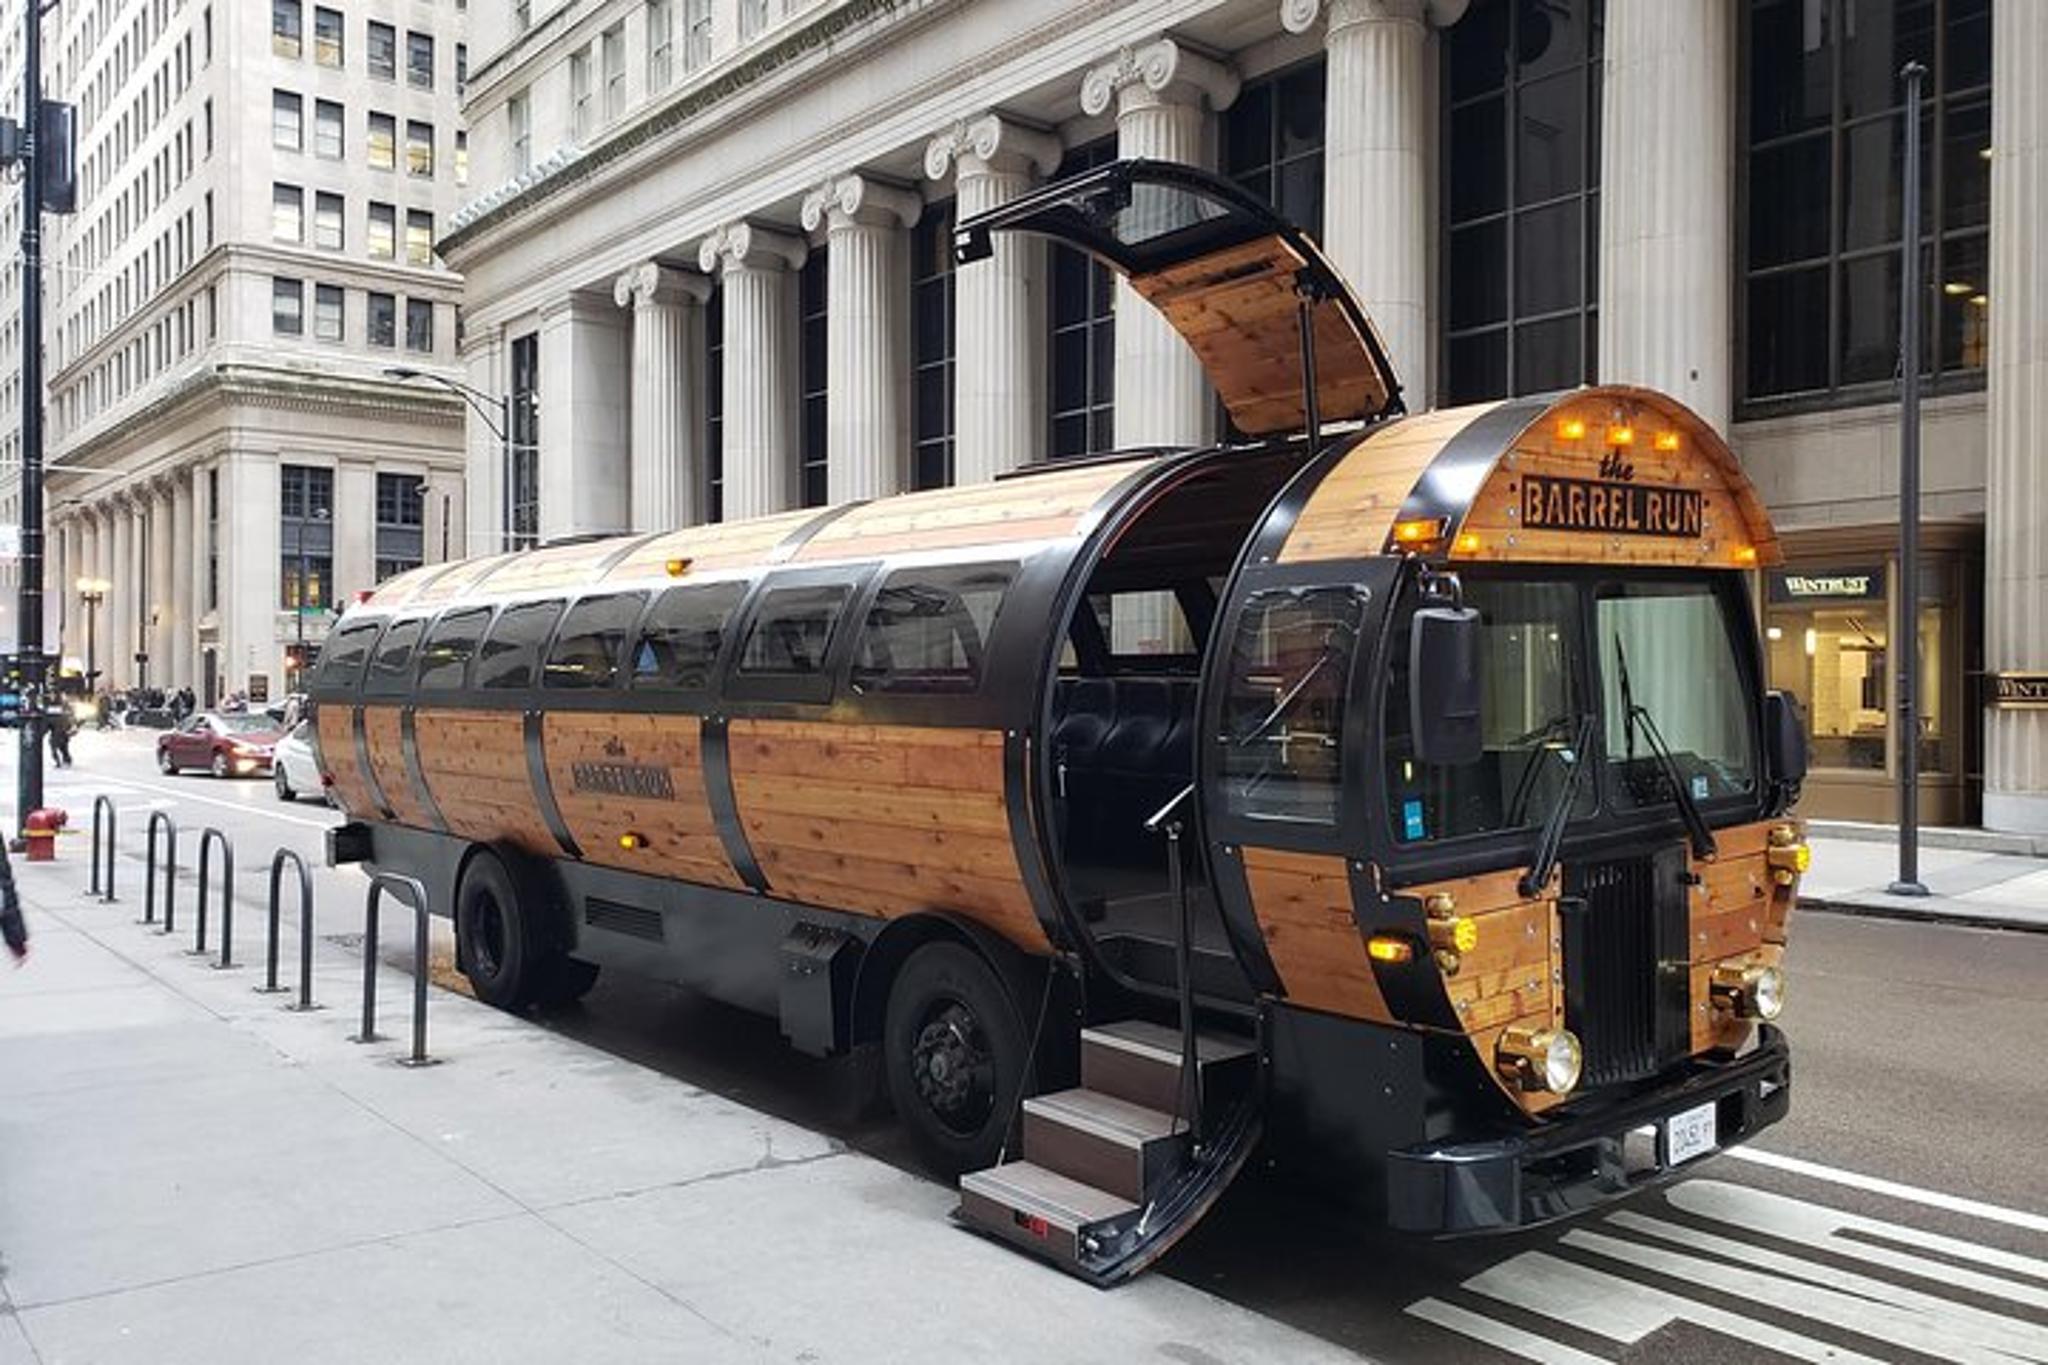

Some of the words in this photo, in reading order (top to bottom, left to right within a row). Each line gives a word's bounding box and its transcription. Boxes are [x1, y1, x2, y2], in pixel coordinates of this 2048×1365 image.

[1599, 447, 1636, 481] the
[1525, 480, 1640, 530] BARREL
[1646, 490, 1700, 534] RUN
